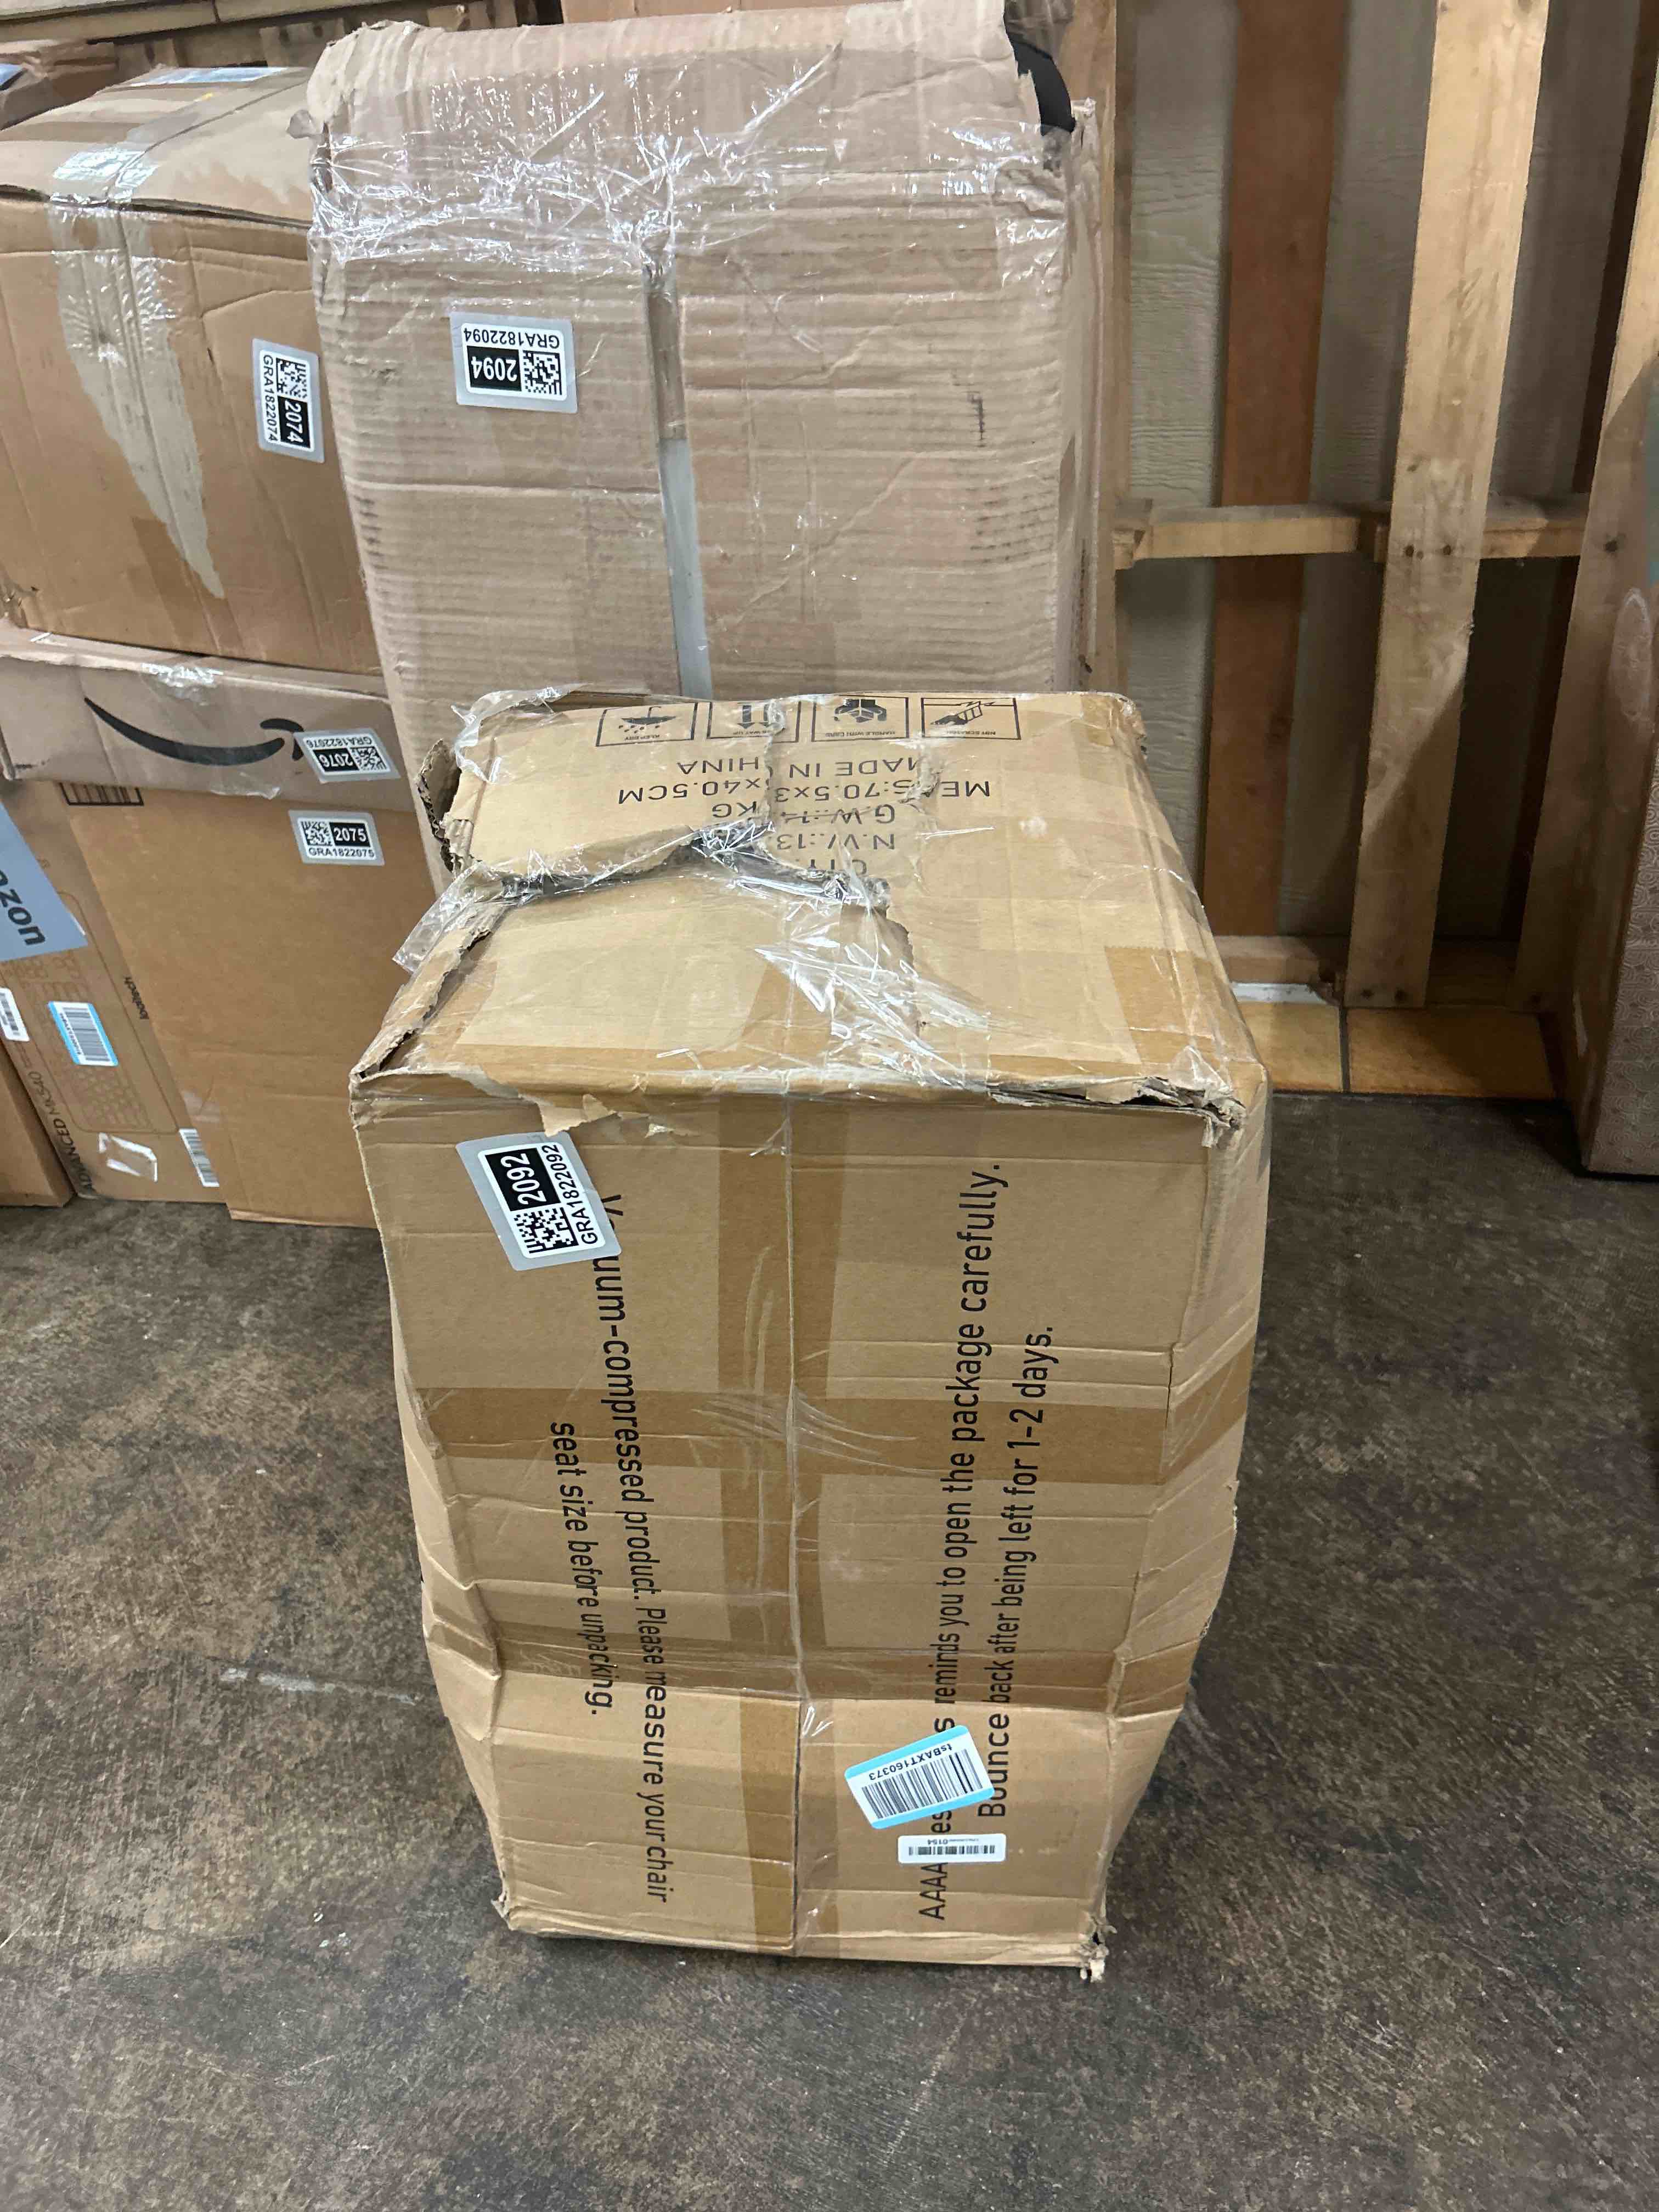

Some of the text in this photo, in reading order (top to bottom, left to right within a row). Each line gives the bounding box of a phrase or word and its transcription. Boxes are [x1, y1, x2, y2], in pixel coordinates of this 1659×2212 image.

[464, 328, 560, 349] GRA1822094
[471, 356, 518, 382] 2094
[263, 354, 279, 441] GRA1822074
[285, 399, 303, 443] 2074
[306, 736, 373, 748] GRA1822076
[319, 753, 353, 768] 2076
[789, 763, 821, 778] IN
[712, 800, 757, 818] KG
[308, 847, 375, 857] GRA1822075
[334, 827, 366, 843] 2075
[500, 1153, 547, 1205] 2092
[541, 1144, 598, 1244] GRA1822092
[956, 1165, 1008, 1312] carefully.
[945, 1324, 992, 1441] package
[940, 1452, 975, 1493] the
[592, 1194, 674, 1903] Vuum-compressed product. Please measure your chair
[944, 1503, 977, 1558] open
[550, 1422, 619, 1715] seat size before unpacking.
[936, 1566, 966, 1585] to
[978, 1327, 1059, 1818] Bounce back after being left for 1-2 days.
[939, 1594, 969, 1627] you
[928, 1633, 961, 1704] reminds
